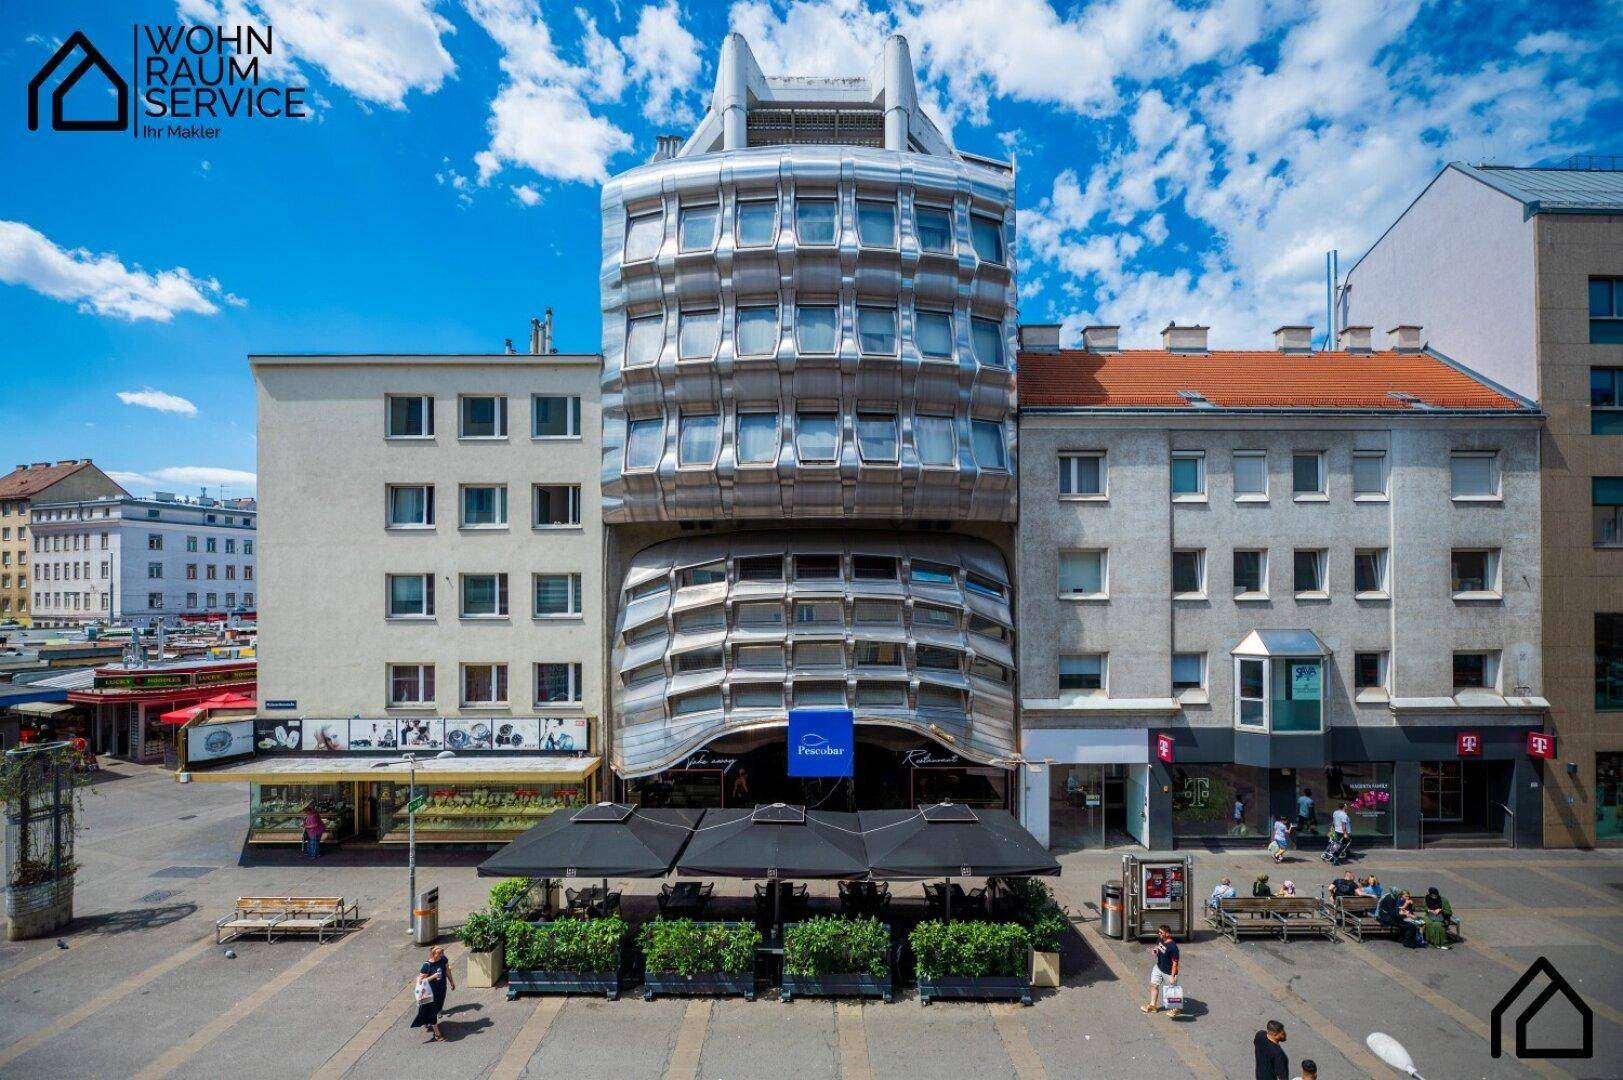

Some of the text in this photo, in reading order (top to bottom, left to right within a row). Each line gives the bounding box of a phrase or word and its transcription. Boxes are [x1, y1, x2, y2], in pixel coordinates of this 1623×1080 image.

[798, 745, 845, 755] Pescobar
[1159, 739, 1169, 758] T
[1462, 736, 1477, 752] T
[1532, 736, 1548, 754] T
[1184, 777, 1210, 807] T
